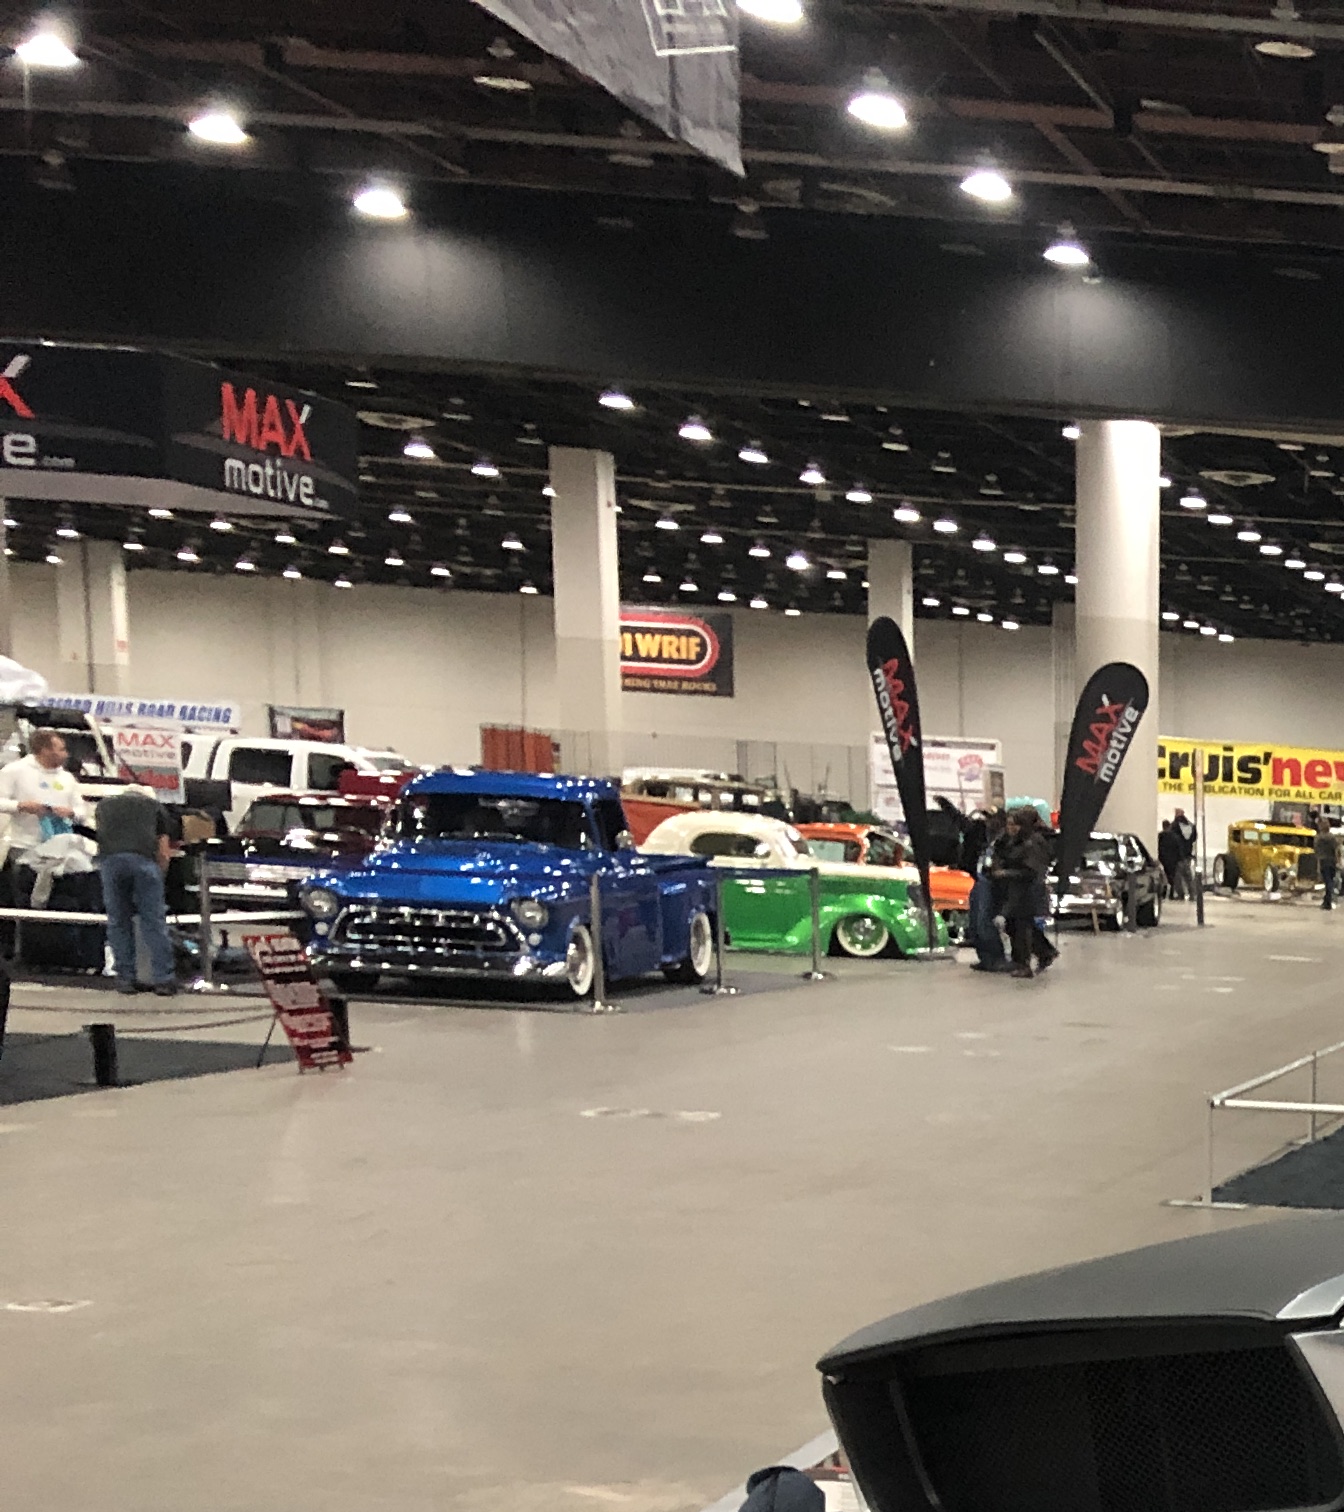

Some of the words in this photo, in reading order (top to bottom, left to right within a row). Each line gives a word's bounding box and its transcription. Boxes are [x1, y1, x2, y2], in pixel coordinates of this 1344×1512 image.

[221, 380, 313, 461] MAX
[634, 632, 702, 661] WRIF
[117, 731, 175, 749] MAX
[872, 668, 903, 763] motive
[883, 657, 919, 752] MAX
[1075, 693, 1126, 775] MAX
[1099, 705, 1140, 783] motive
[1162, 781, 1185, 792] THE
[1188, 783, 1265, 797] PBLICATION
[1268, 787, 1291, 799] FOR
[1295, 788, 1315, 800] ALL
[1318, 790, 1342, 801] CAR
